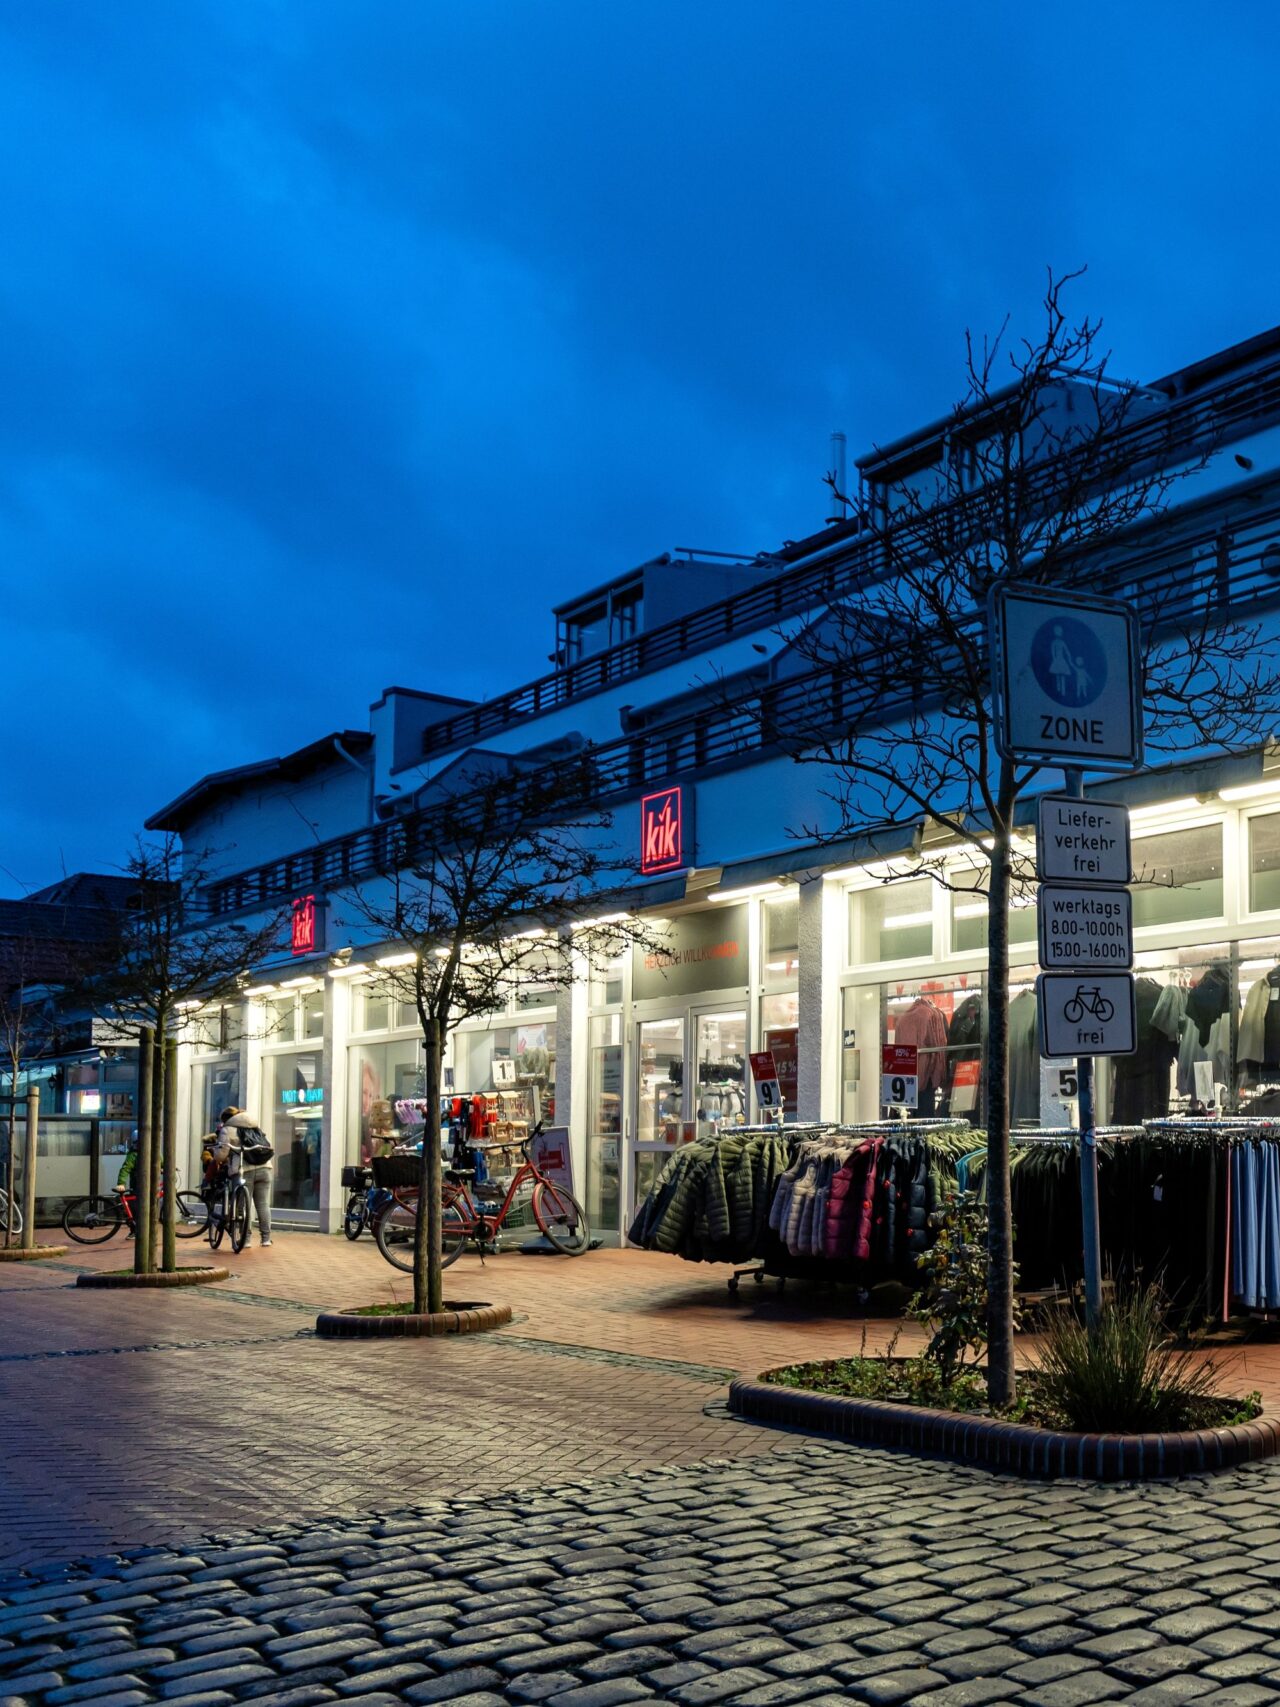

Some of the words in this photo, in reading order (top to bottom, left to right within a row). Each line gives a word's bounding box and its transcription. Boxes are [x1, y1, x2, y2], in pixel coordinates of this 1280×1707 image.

[1040, 714, 1104, 744] ZONE
[1058, 808, 1111, 828] Liefer-
[645, 796, 678, 863] kik
[1054, 832, 1116, 851] verkehr
[1074, 854, 1100, 873] frei
[1052, 898, 1121, 918] werktags
[1051, 919, 1124, 936] 8.00-10.00h
[1077, 1027, 1104, 1044] frei
[499, 1062, 506, 1080] 1
[891, 1076, 906, 1102] 9
[1059, 1069, 1078, 1097] 5
[761, 1082, 773, 1106] 9
